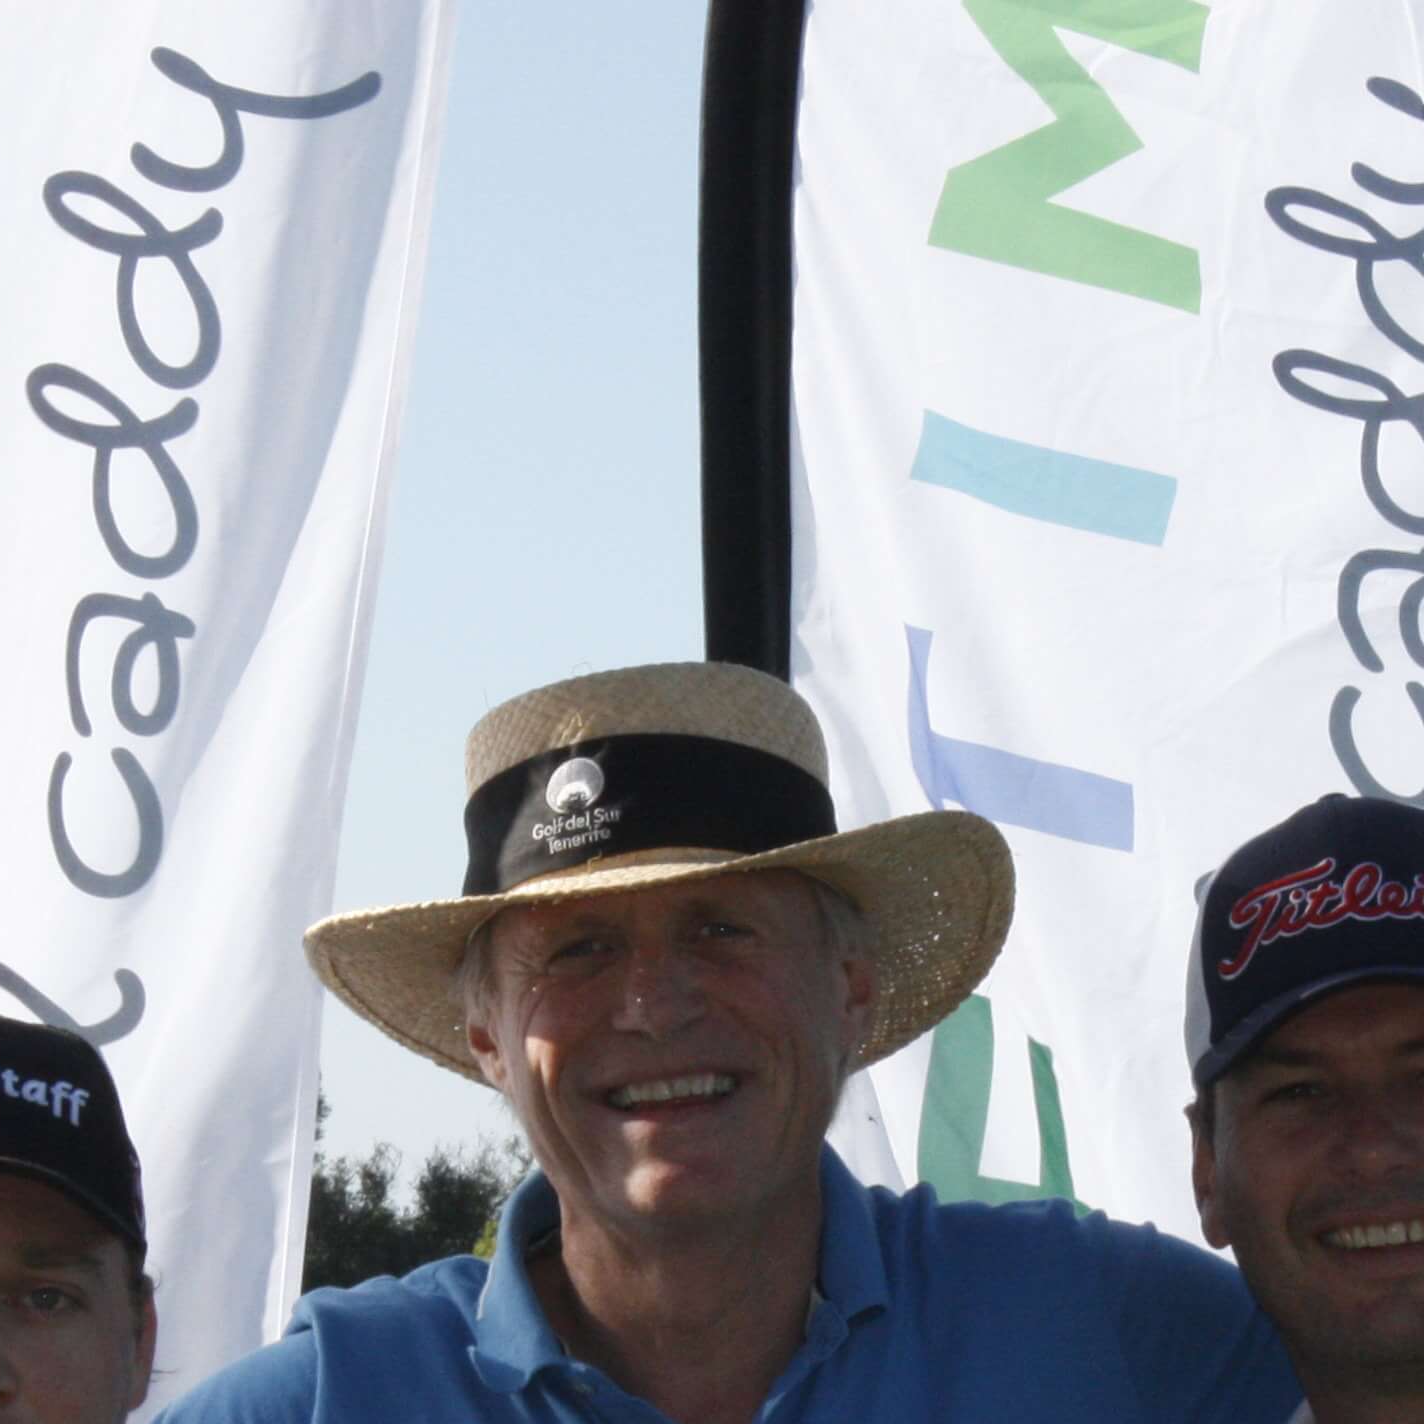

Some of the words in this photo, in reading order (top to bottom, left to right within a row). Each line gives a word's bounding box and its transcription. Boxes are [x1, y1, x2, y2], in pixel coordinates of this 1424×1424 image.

[26, 46, 382, 899] caddy
[532, 815, 564, 841] Golf
[565, 810, 590, 830] del
